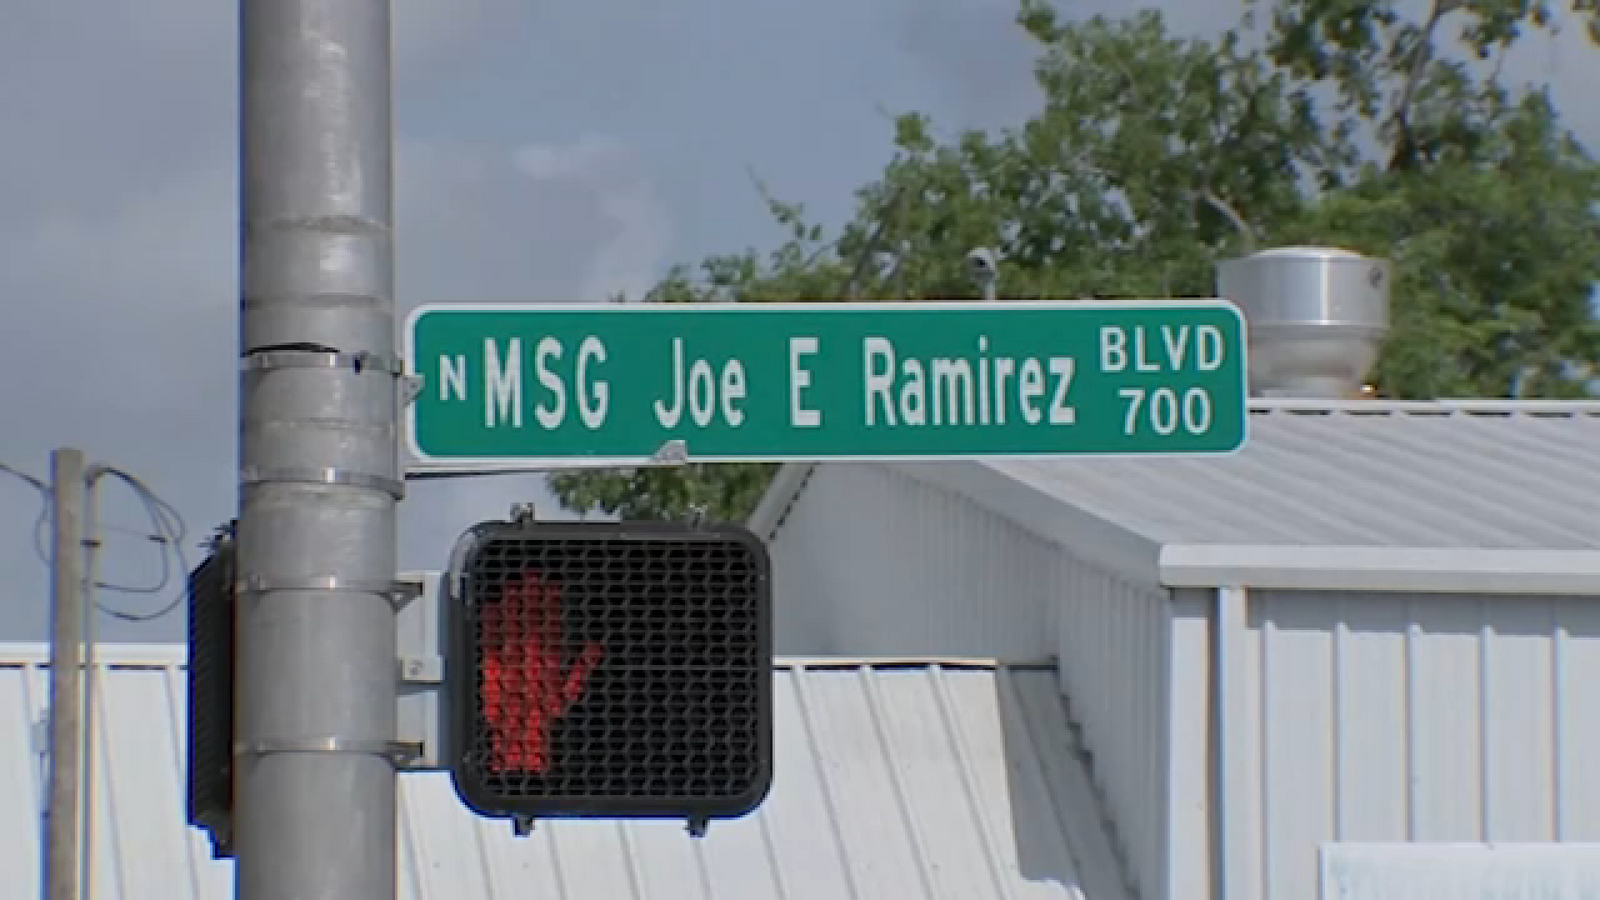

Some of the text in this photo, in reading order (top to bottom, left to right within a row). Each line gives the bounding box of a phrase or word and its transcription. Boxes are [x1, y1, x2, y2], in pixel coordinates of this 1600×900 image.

[1100, 325, 1223, 372] BLVD
[439, 335, 1076, 429] N MSG Joe E Ramirez
[1119, 388, 1211, 436] 700
